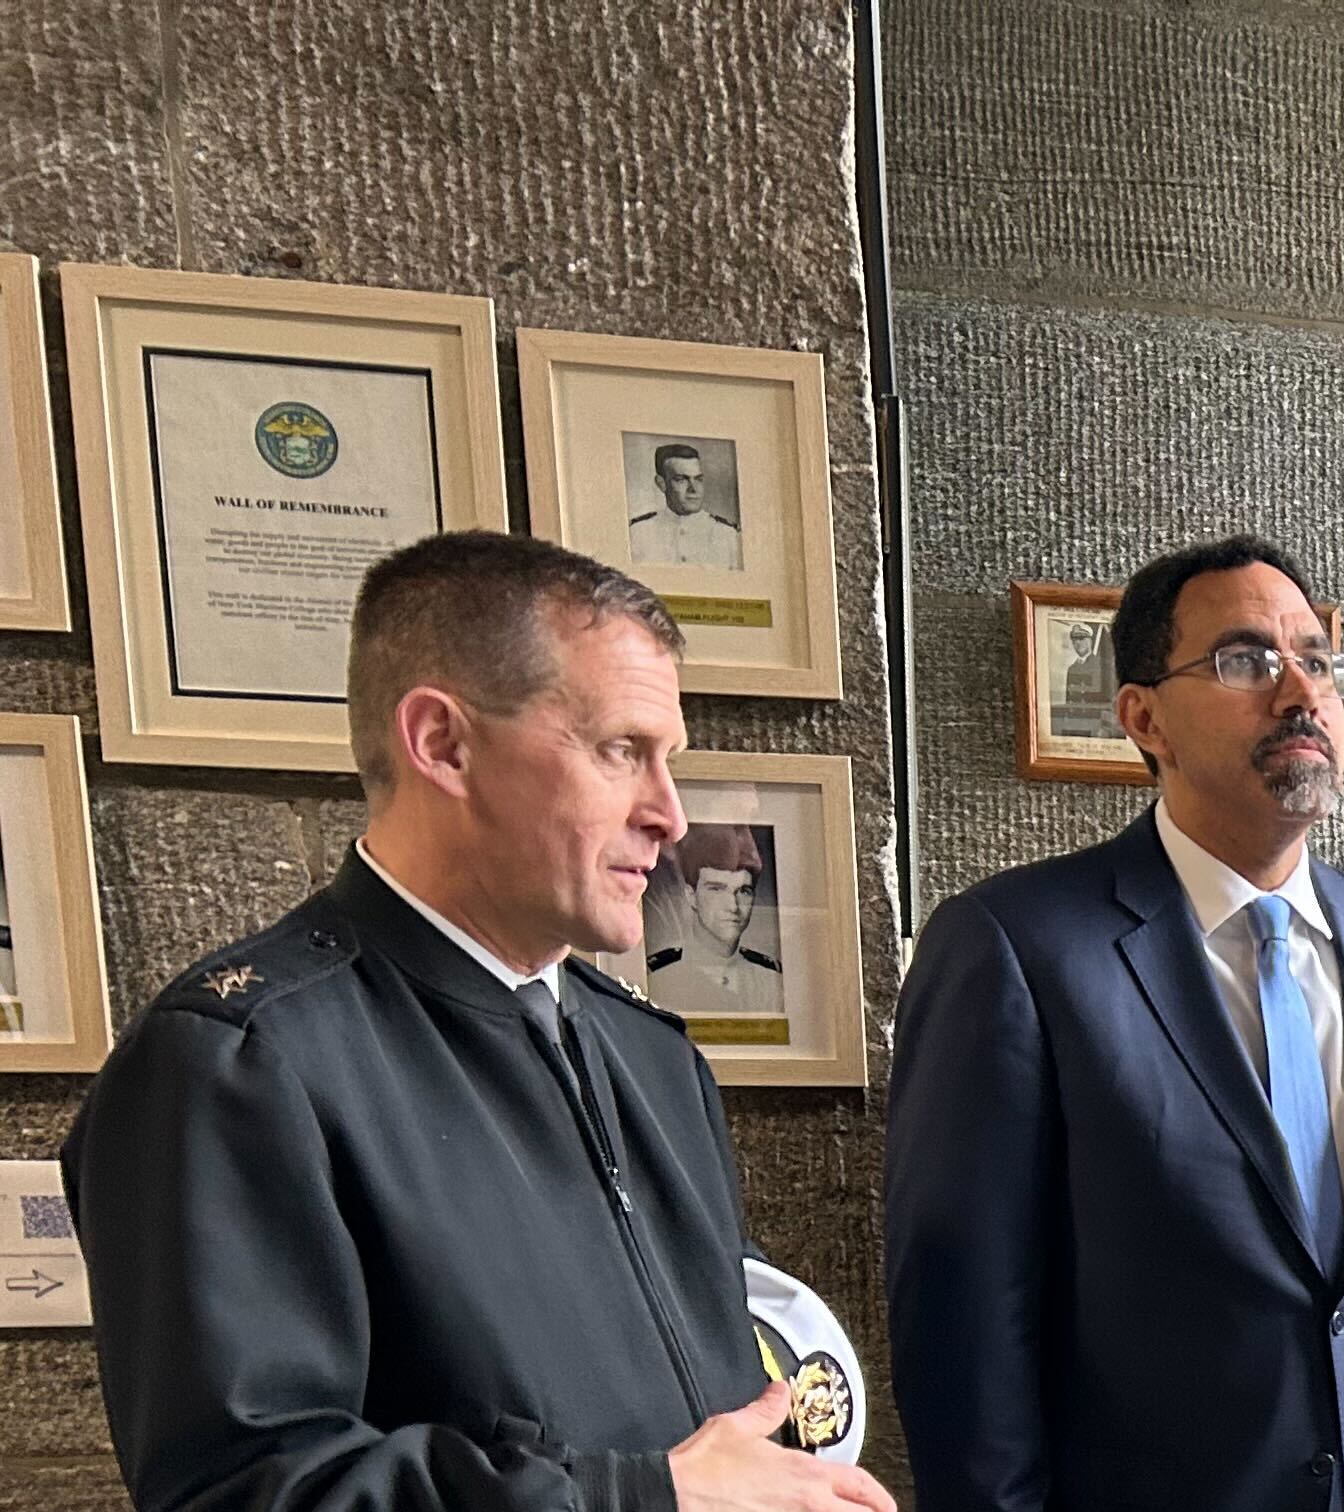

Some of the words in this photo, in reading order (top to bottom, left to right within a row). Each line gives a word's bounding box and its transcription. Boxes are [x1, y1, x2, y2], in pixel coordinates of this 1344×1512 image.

[214, 496, 253, 509] WALL
[256, 498, 275, 511] OF
[280, 501, 389, 518] REMEMBRANCE
